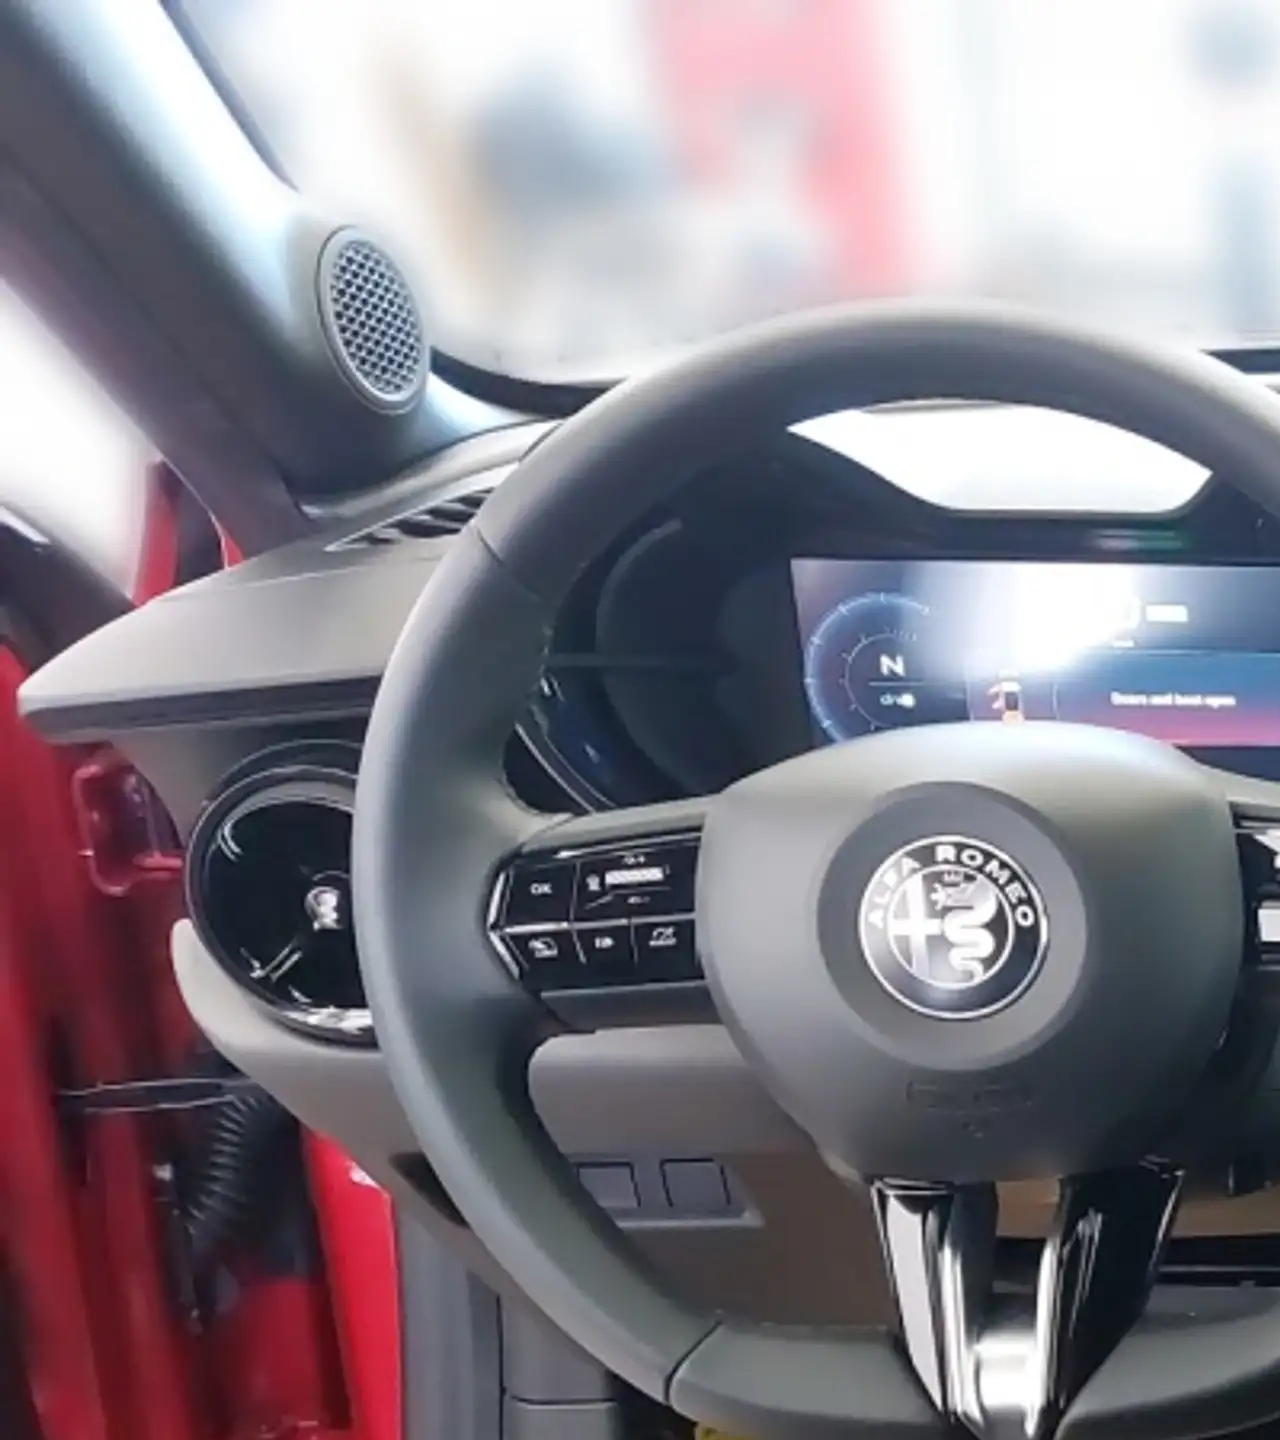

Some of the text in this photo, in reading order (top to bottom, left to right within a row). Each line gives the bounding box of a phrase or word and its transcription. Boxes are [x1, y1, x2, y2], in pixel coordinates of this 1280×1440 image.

[880, 654, 905, 676] N
[868, 844, 1036, 930] ALFA ROMEO
